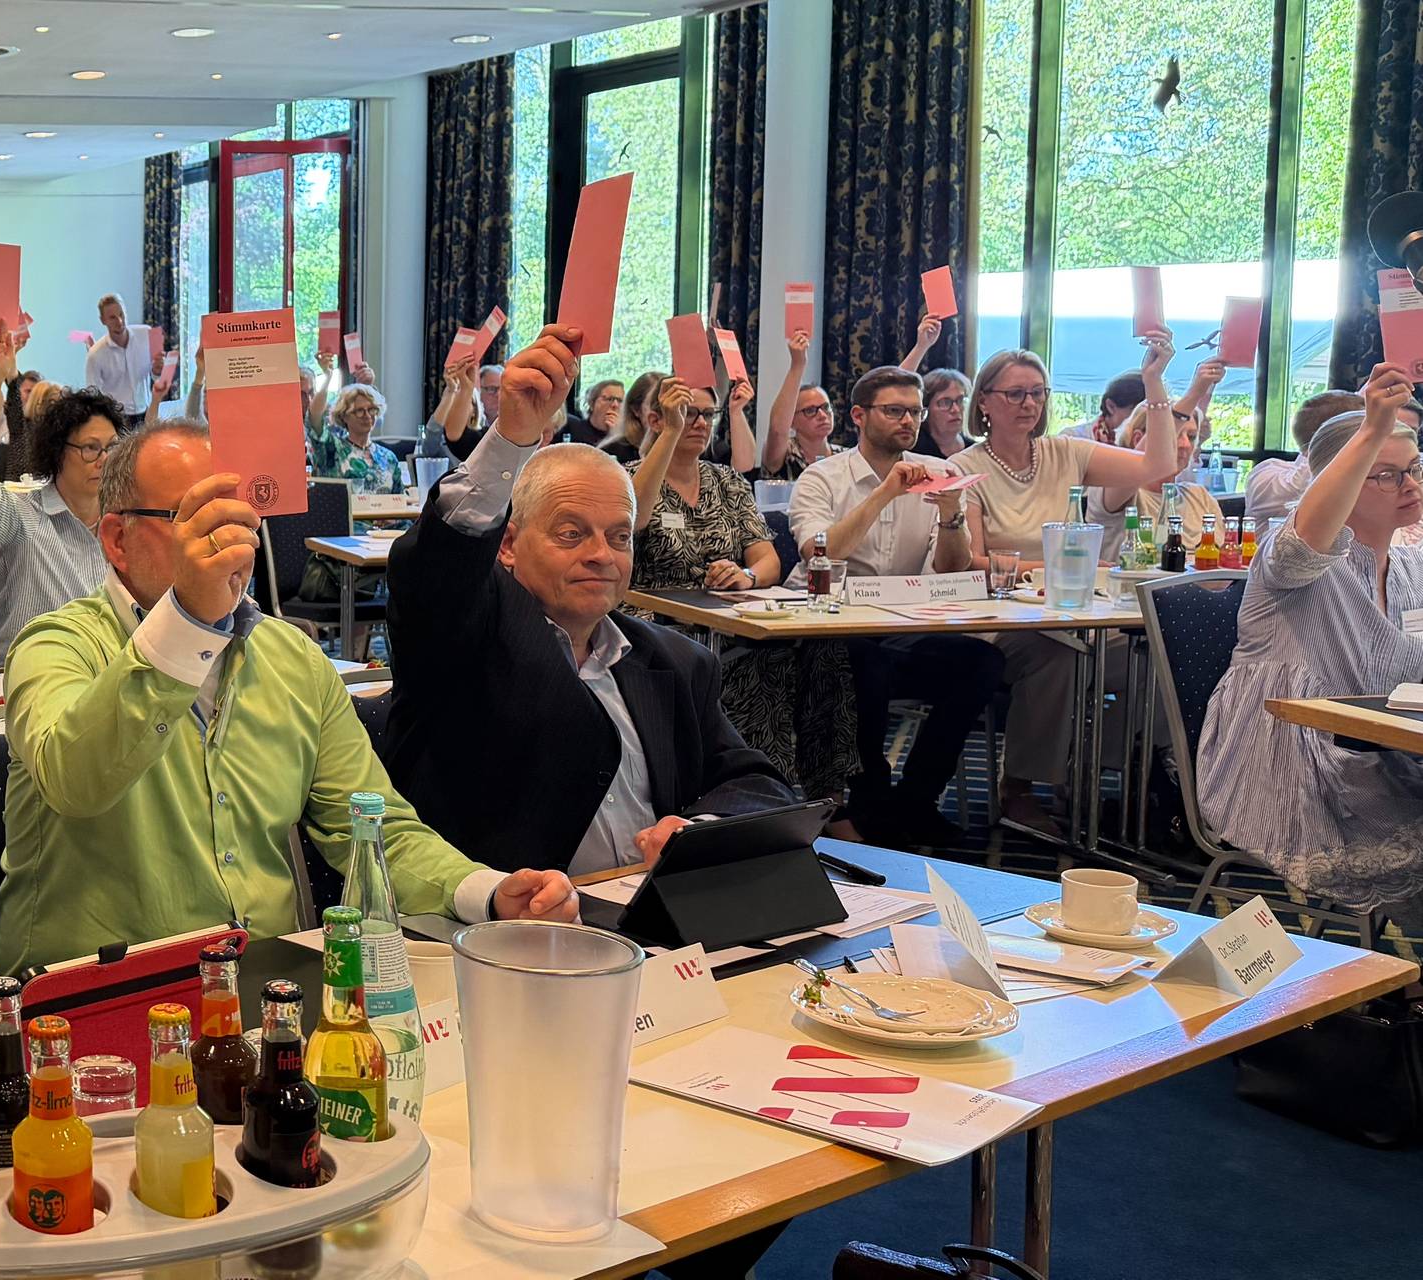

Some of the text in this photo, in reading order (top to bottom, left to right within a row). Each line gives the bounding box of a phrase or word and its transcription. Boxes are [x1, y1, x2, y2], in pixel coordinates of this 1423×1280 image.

[216, 320, 281, 334] Stimmkarte
[930, 587, 957, 598] Schmidt
[634, 1013, 655, 1033] en
